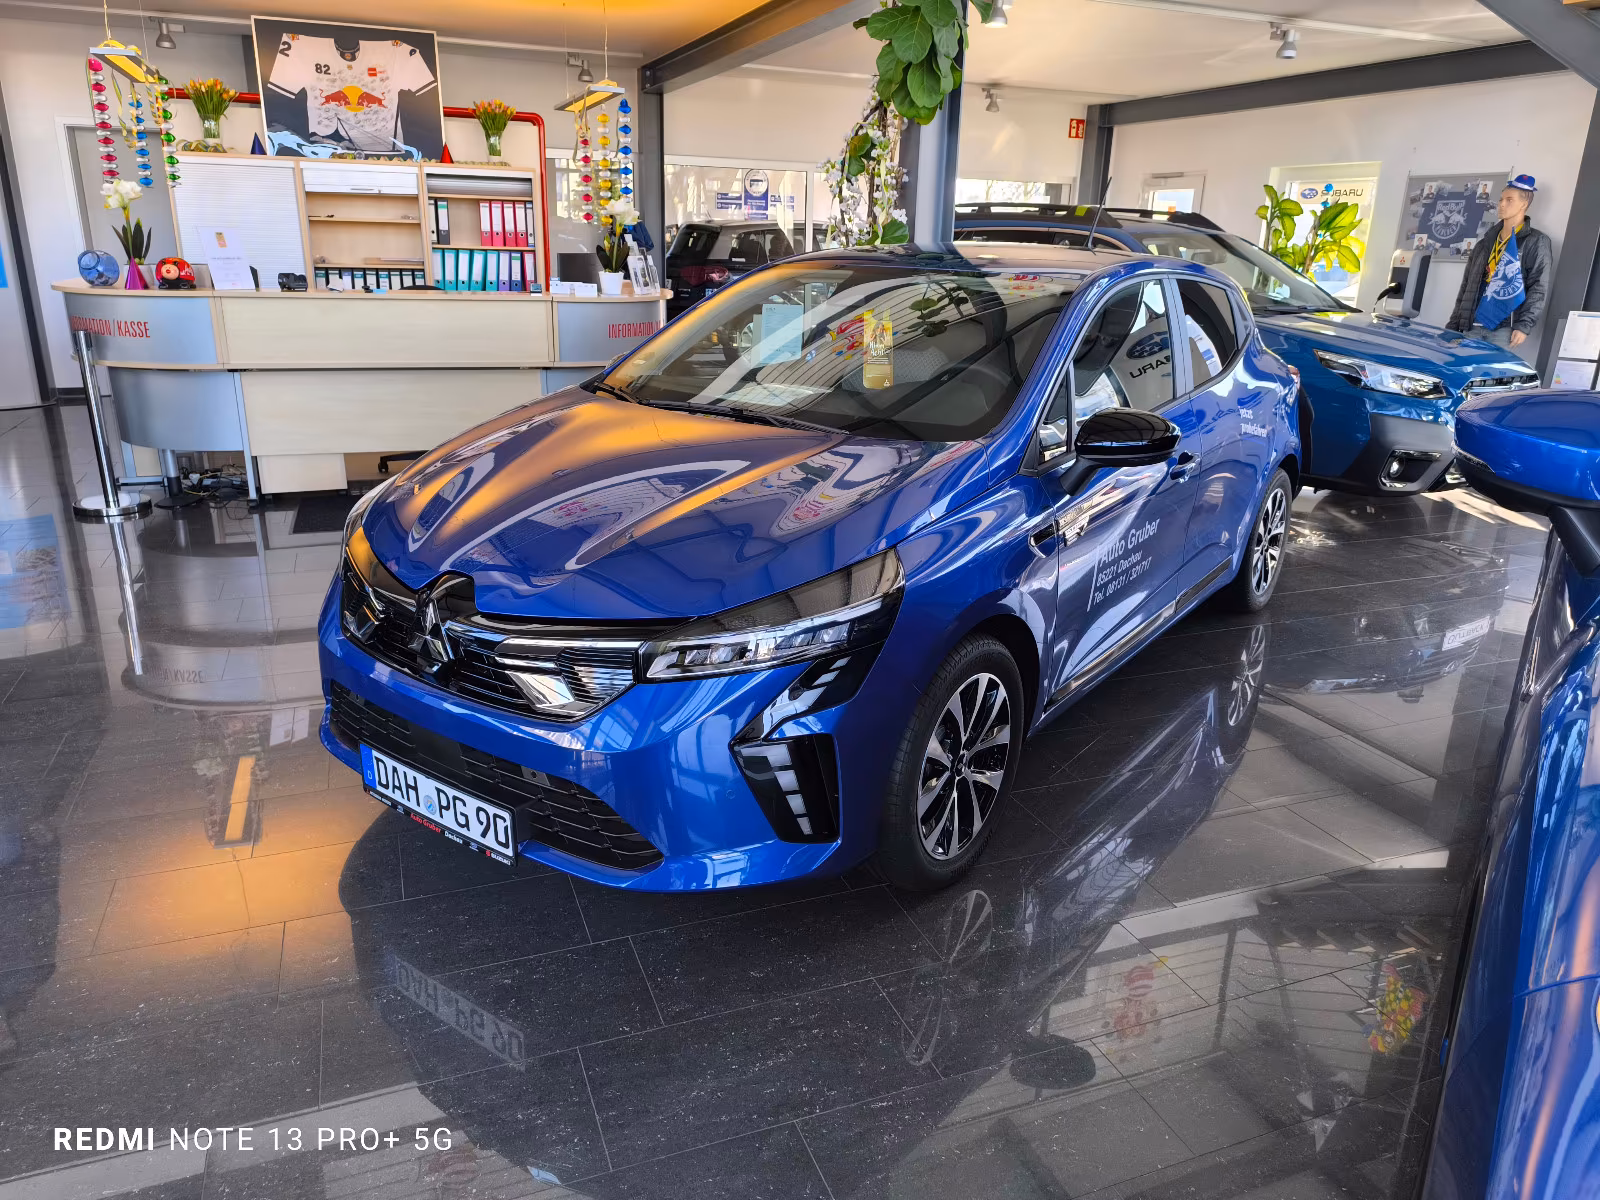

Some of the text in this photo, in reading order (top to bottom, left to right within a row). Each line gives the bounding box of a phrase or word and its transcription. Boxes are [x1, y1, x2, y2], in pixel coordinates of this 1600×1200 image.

[315, 63, 331, 75] 82
[117, 321, 150, 338] KASSE
[1100, 518, 1160, 567] Auto Gruber
[1096, 550, 1143, 587] 85221 Dachau
[374, 755, 510, 850] DAH PG 90
[422, 818, 442, 834] Gruber
